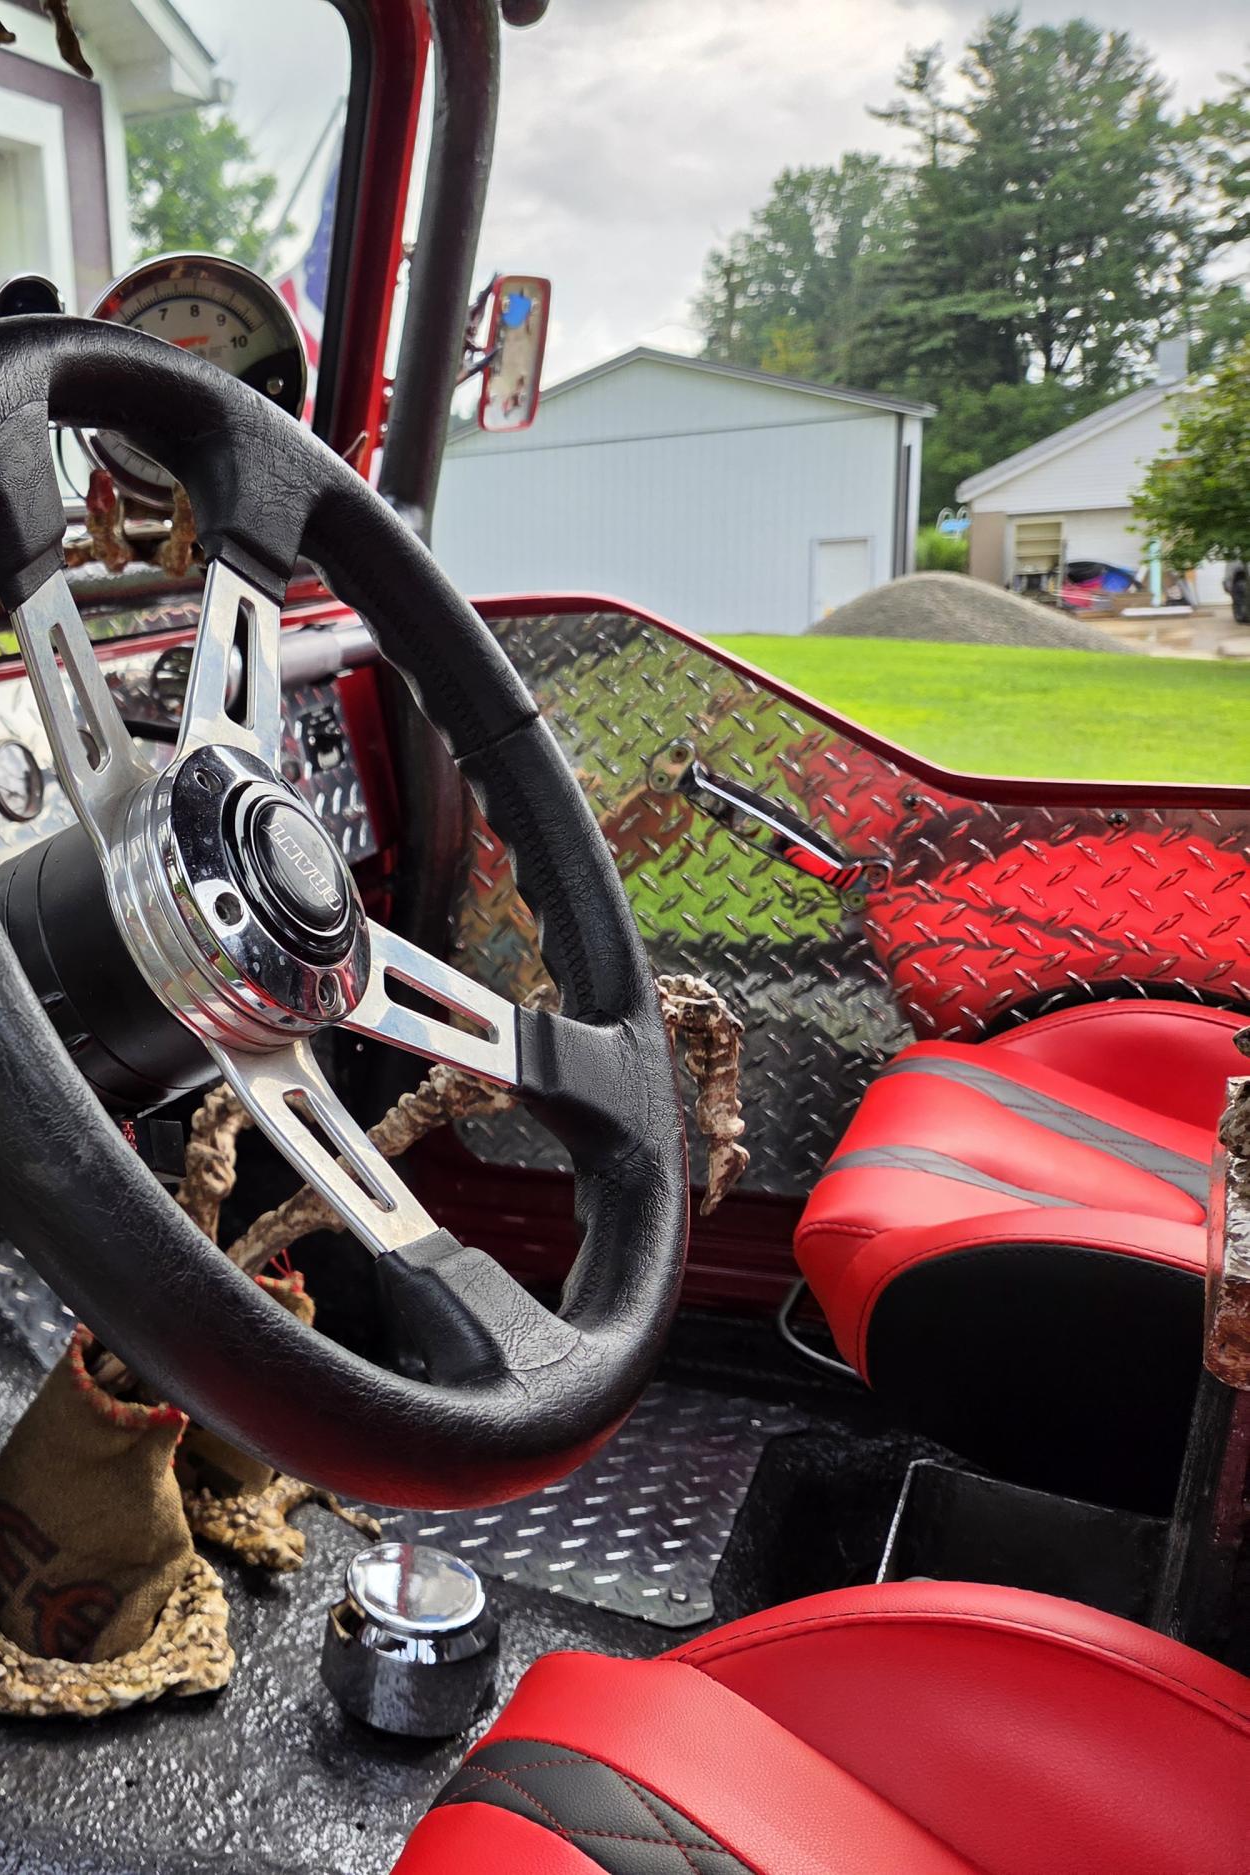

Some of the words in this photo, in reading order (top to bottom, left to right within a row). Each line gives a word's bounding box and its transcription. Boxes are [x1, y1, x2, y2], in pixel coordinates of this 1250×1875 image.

[158, 308, 169, 321] 7
[190, 304, 200, 317] 8
[216, 314, 227, 327] 9
[230, 335, 248, 349] 10
[260, 822, 344, 911] GRANT
